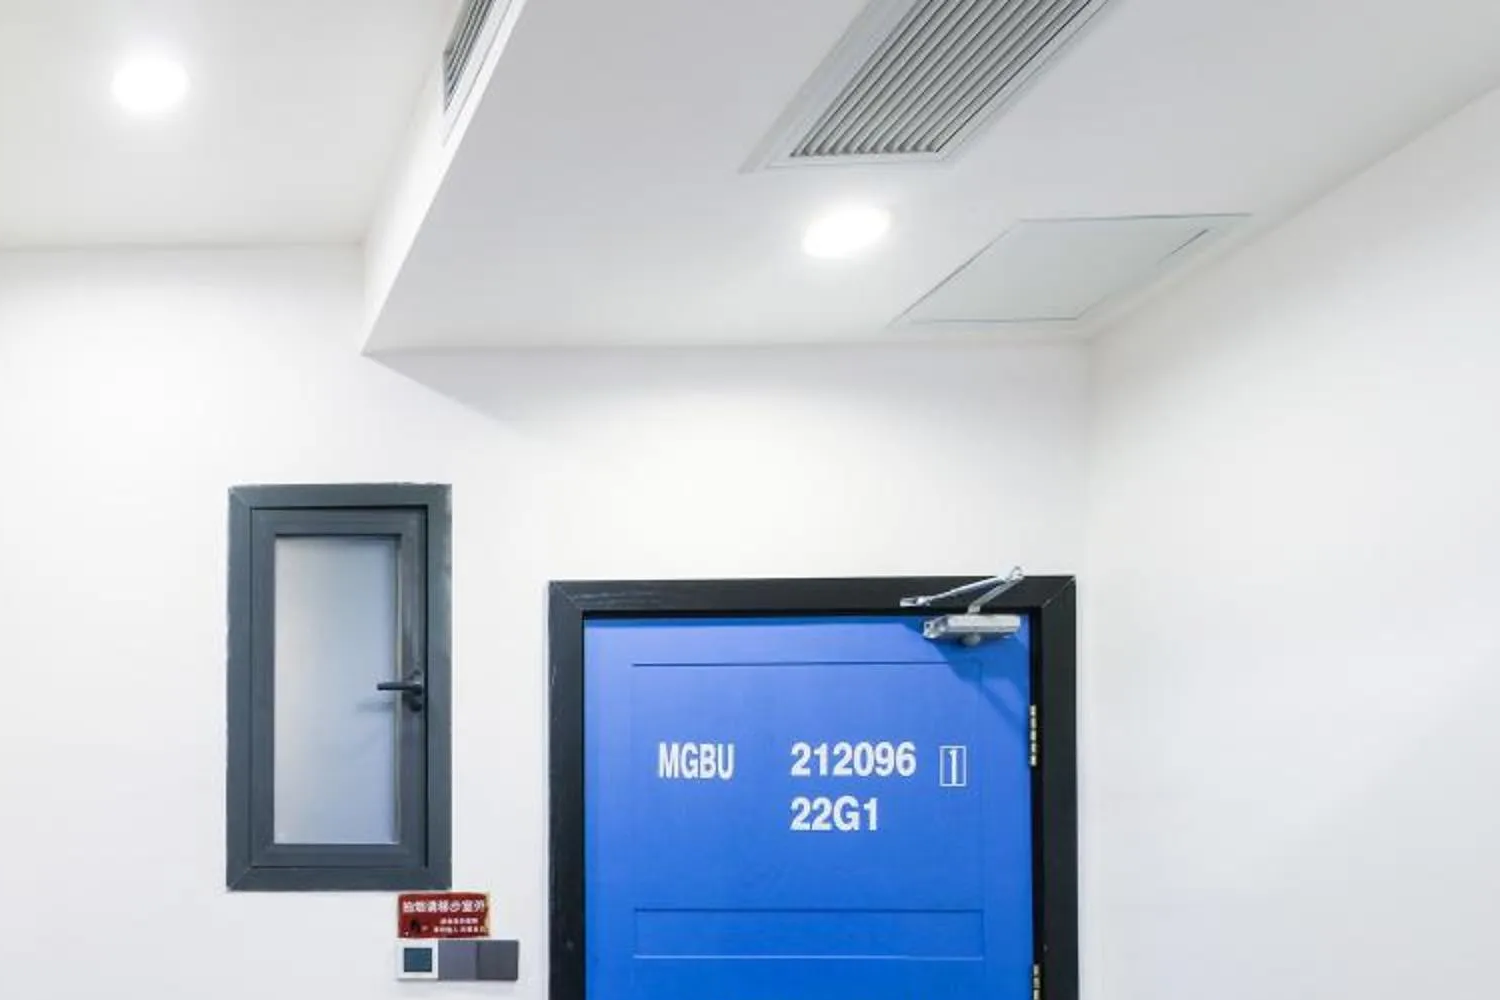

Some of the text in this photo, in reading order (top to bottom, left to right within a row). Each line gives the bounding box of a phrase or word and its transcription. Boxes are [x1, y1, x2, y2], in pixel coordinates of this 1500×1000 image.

[658, 742, 734, 779] MGBU
[790, 741, 916, 776] 212096
[790, 795, 878, 831] 22G1
